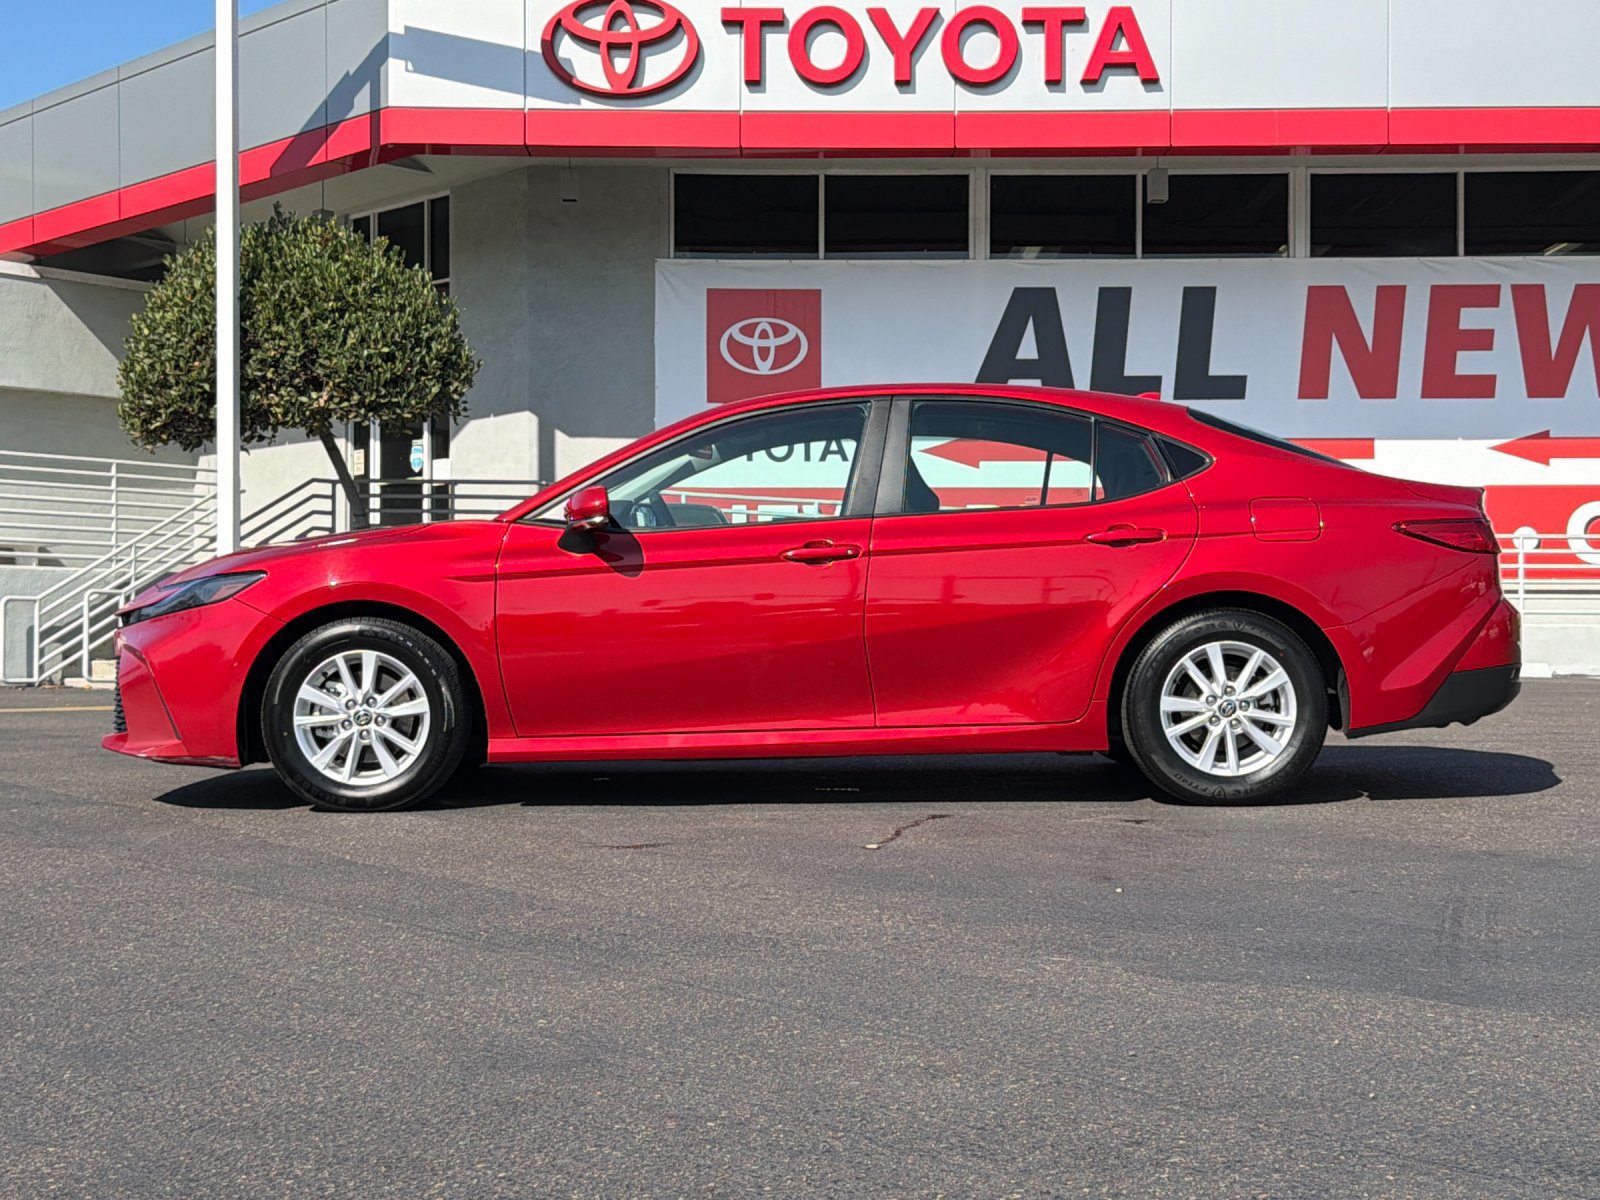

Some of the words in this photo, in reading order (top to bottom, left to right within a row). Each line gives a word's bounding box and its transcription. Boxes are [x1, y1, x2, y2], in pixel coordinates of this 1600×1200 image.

[721, 6, 1161, 86] TOYOTA
[974, 286, 1248, 400] ALL
[1298, 283, 1600, 400] NEW
